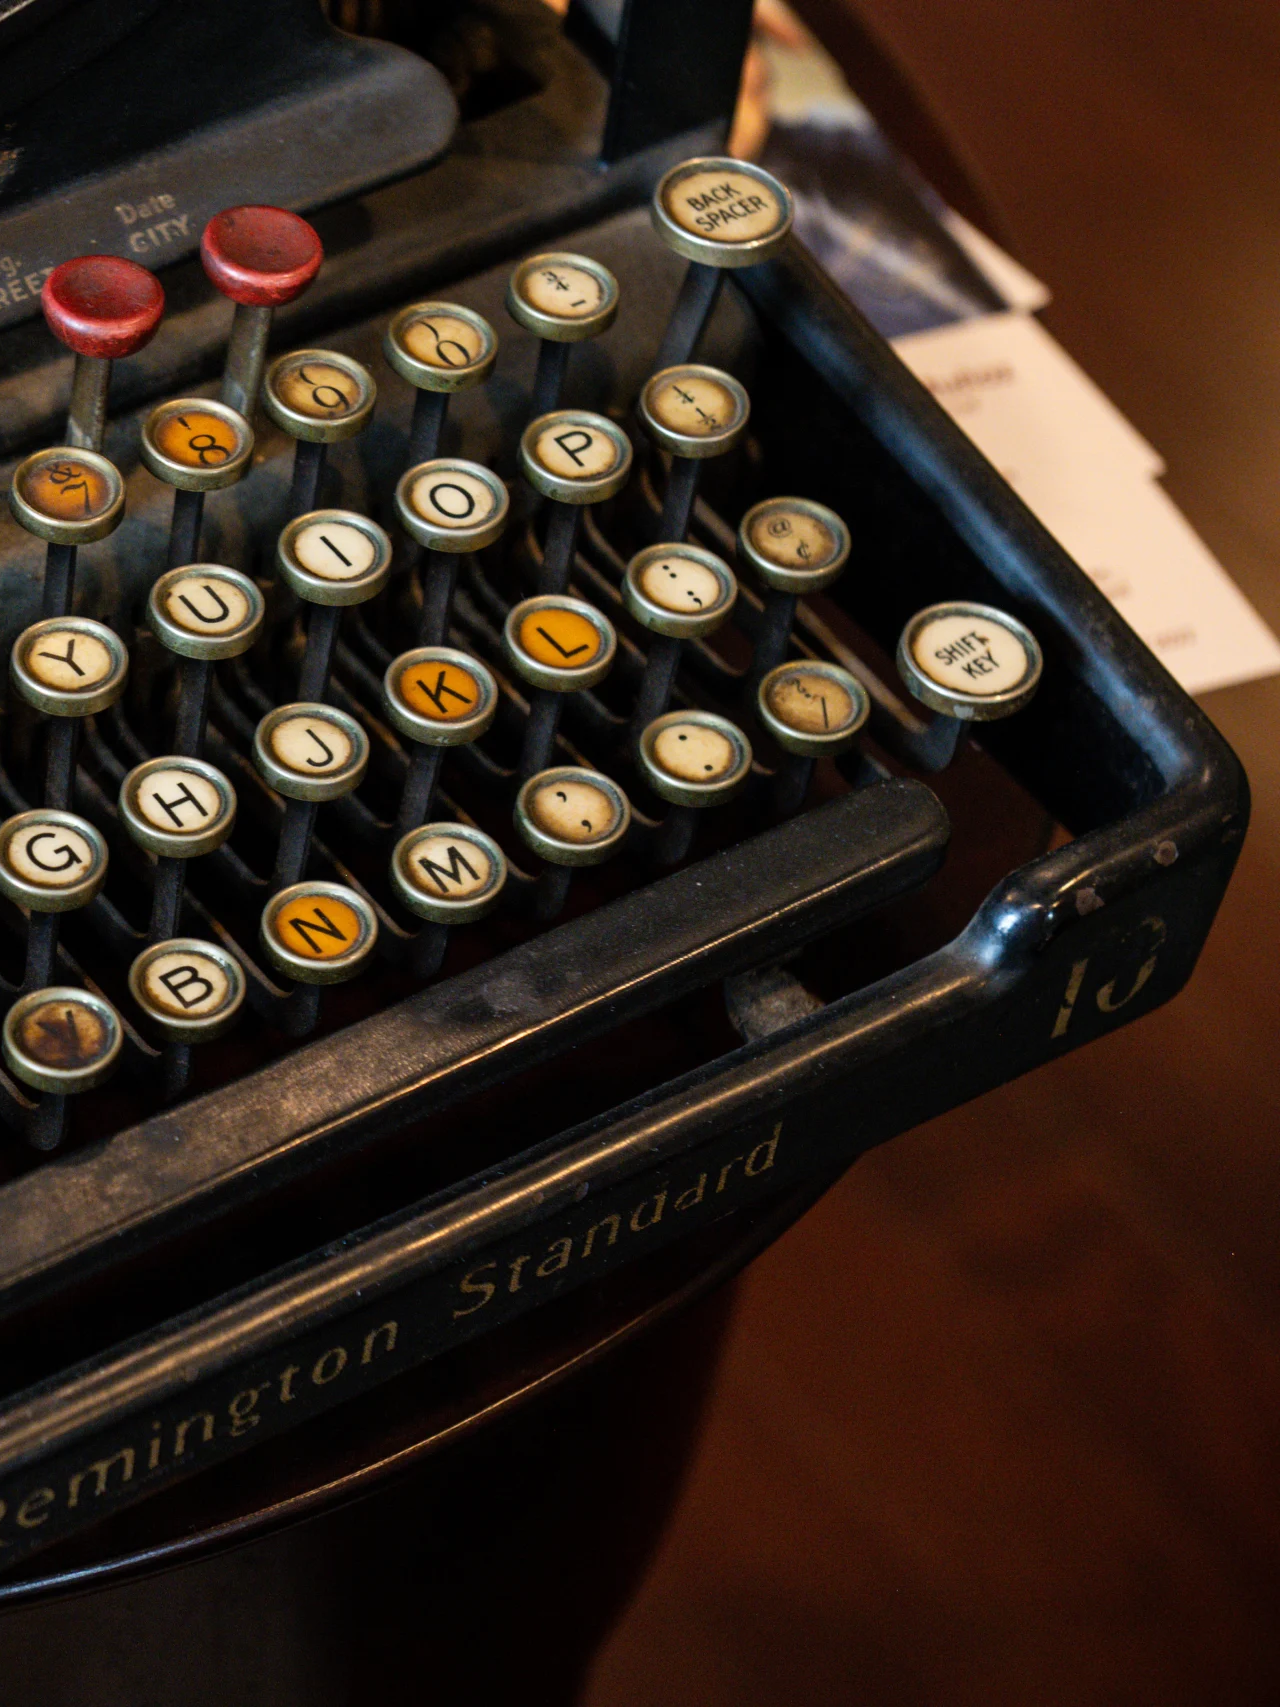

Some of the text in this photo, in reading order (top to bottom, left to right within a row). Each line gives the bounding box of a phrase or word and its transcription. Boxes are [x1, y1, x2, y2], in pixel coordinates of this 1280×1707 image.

[115, 193, 176, 225] Date
[687, 181, 742, 212] BACK
[695, 194, 768, 233] SPACER
[189, 433, 230, 466] 8
[554, 431, 594, 467] P
[429, 483, 476, 519] O
[768, 518, 793, 539] @
[319, 535, 353, 567] I
[179, 585, 230, 624] U
[38, 639, 85, 677] Y
[537, 626, 589, 659] L
[935, 631, 988, 667] SHIFT
[962, 654, 1002, 680] KEY
[416, 670, 473, 714] K
[305, 729, 334, 767] J
[152, 782, 208, 828] H
[25, 832, 83, 873] G
[419, 846, 481, 893] M
[289, 907, 348, 955] N
[159, 965, 214, 1009] B
[452, 1121, 784, 1322] Standard
